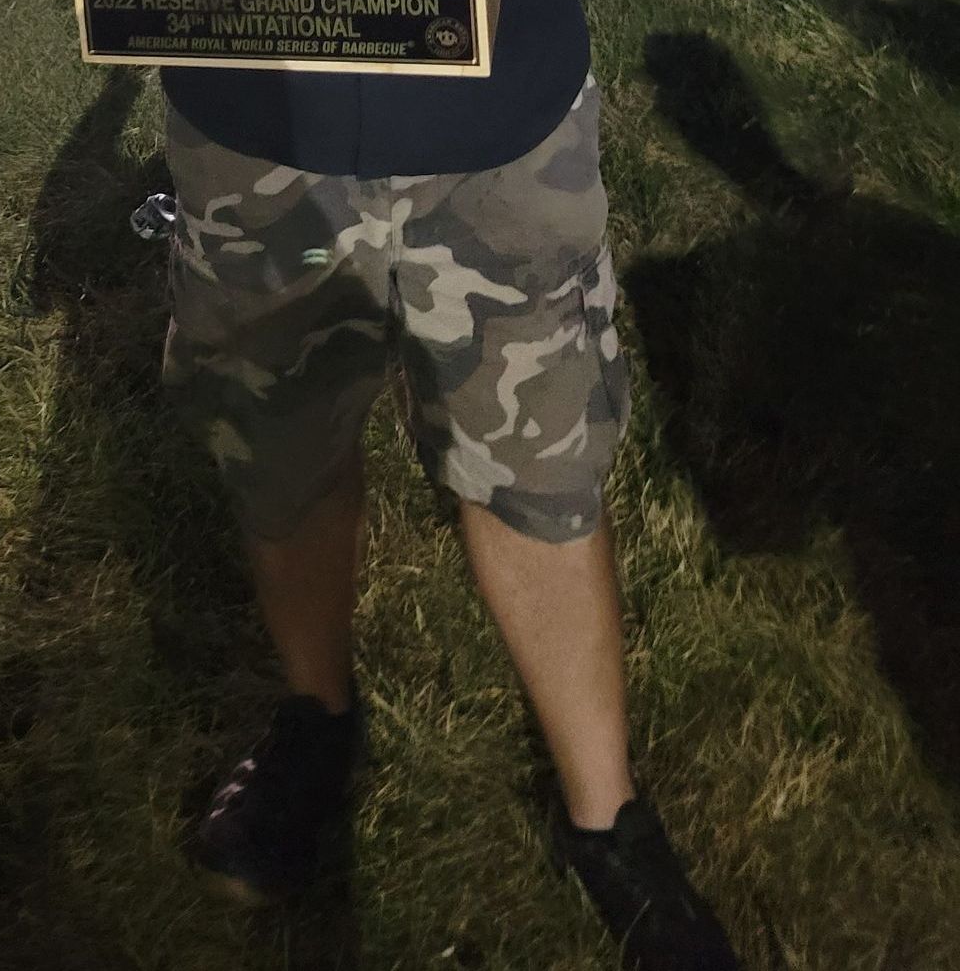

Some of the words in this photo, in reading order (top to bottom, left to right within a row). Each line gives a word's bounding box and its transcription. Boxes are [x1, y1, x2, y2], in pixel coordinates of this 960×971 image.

[166, 13, 205, 34] 34TH
[211, 13, 361, 38] INVITATIONAL
[127, 36, 189, 50] AMERICAN
[191, 37, 227, 51] ROYAL
[231, 39, 273, 52] WORLD
[276, 40, 318, 53] SERIES
[322, 41, 337, 54] OF
